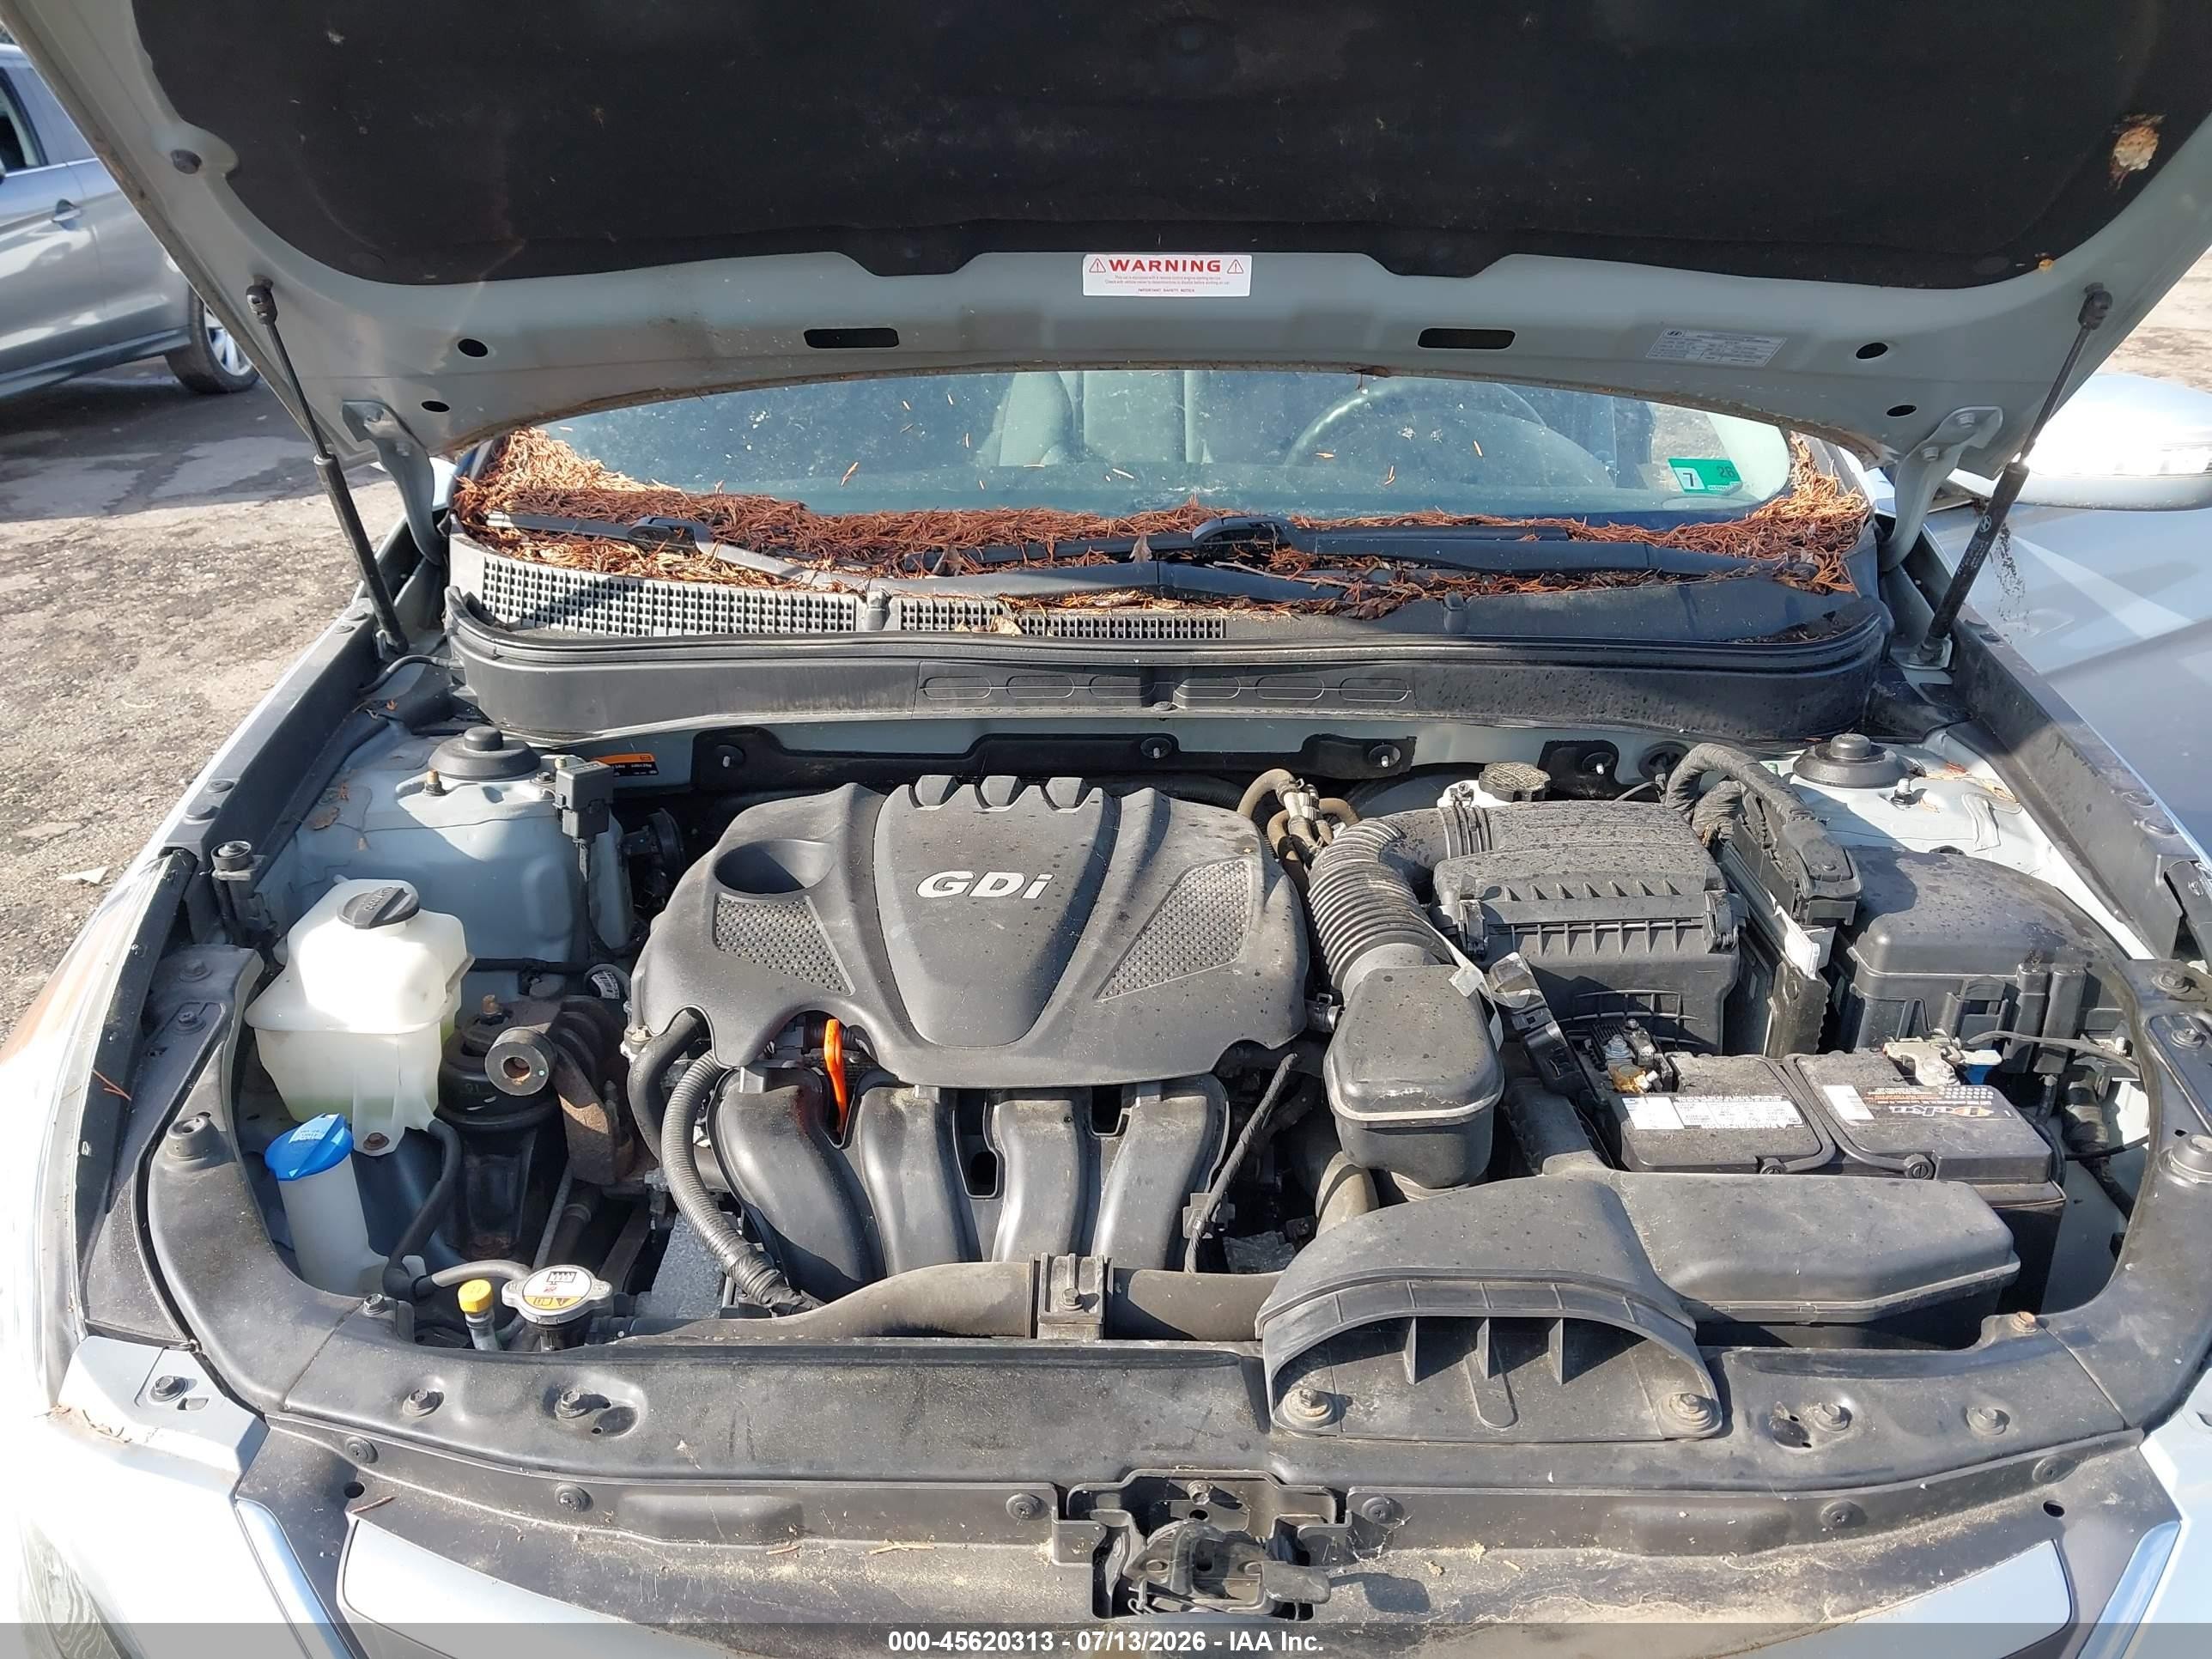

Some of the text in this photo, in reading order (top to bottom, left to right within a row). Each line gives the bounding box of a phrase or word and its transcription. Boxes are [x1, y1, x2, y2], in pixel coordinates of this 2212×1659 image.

[1109, 259, 1221, 272] WARNING
[1682, 472, 1694, 487] 7
[915, 871, 1054, 899] GDi
